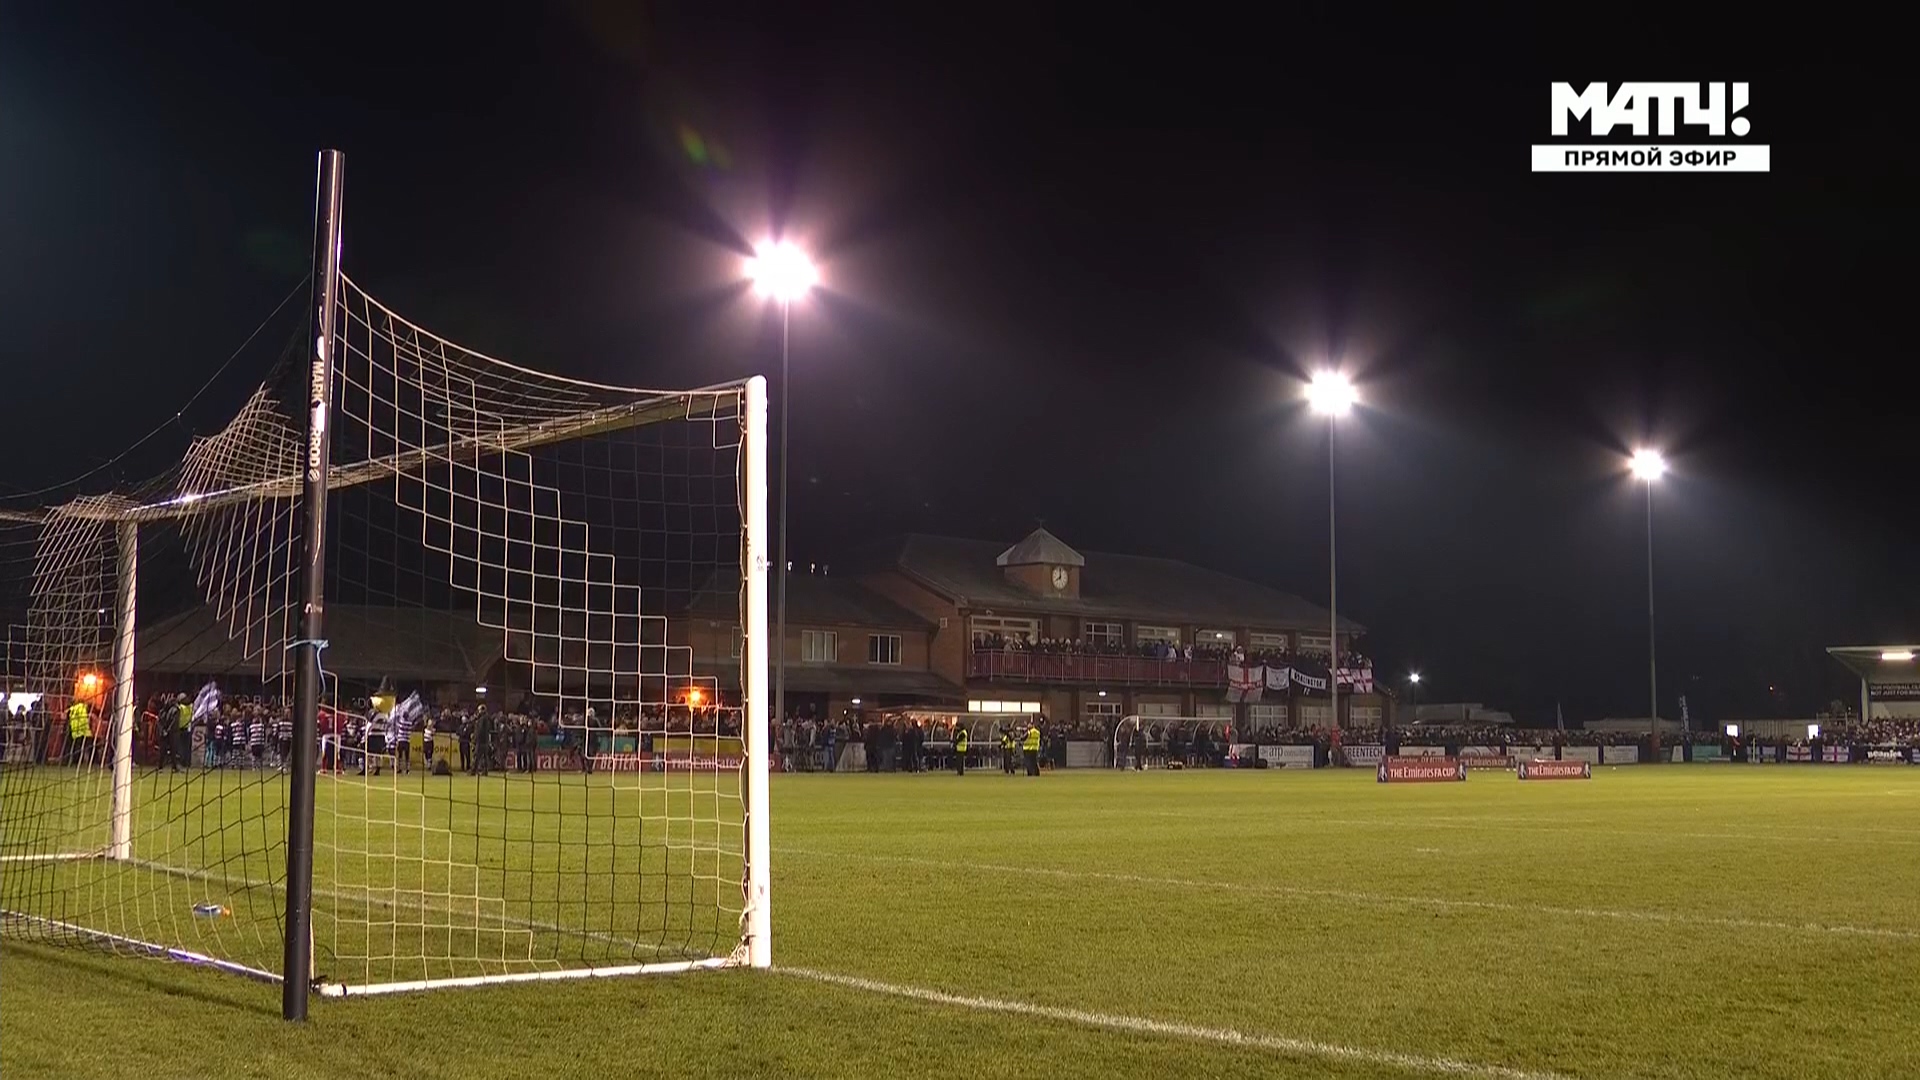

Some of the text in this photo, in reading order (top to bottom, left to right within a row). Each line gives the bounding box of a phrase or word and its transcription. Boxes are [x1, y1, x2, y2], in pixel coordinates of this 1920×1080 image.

[309, 361, 325, 467] MARK RROD
[1390, 766, 1456, 779] THE Emirates FA CUP
[1528, 764, 1583, 776] THE Emirates FA CUP
